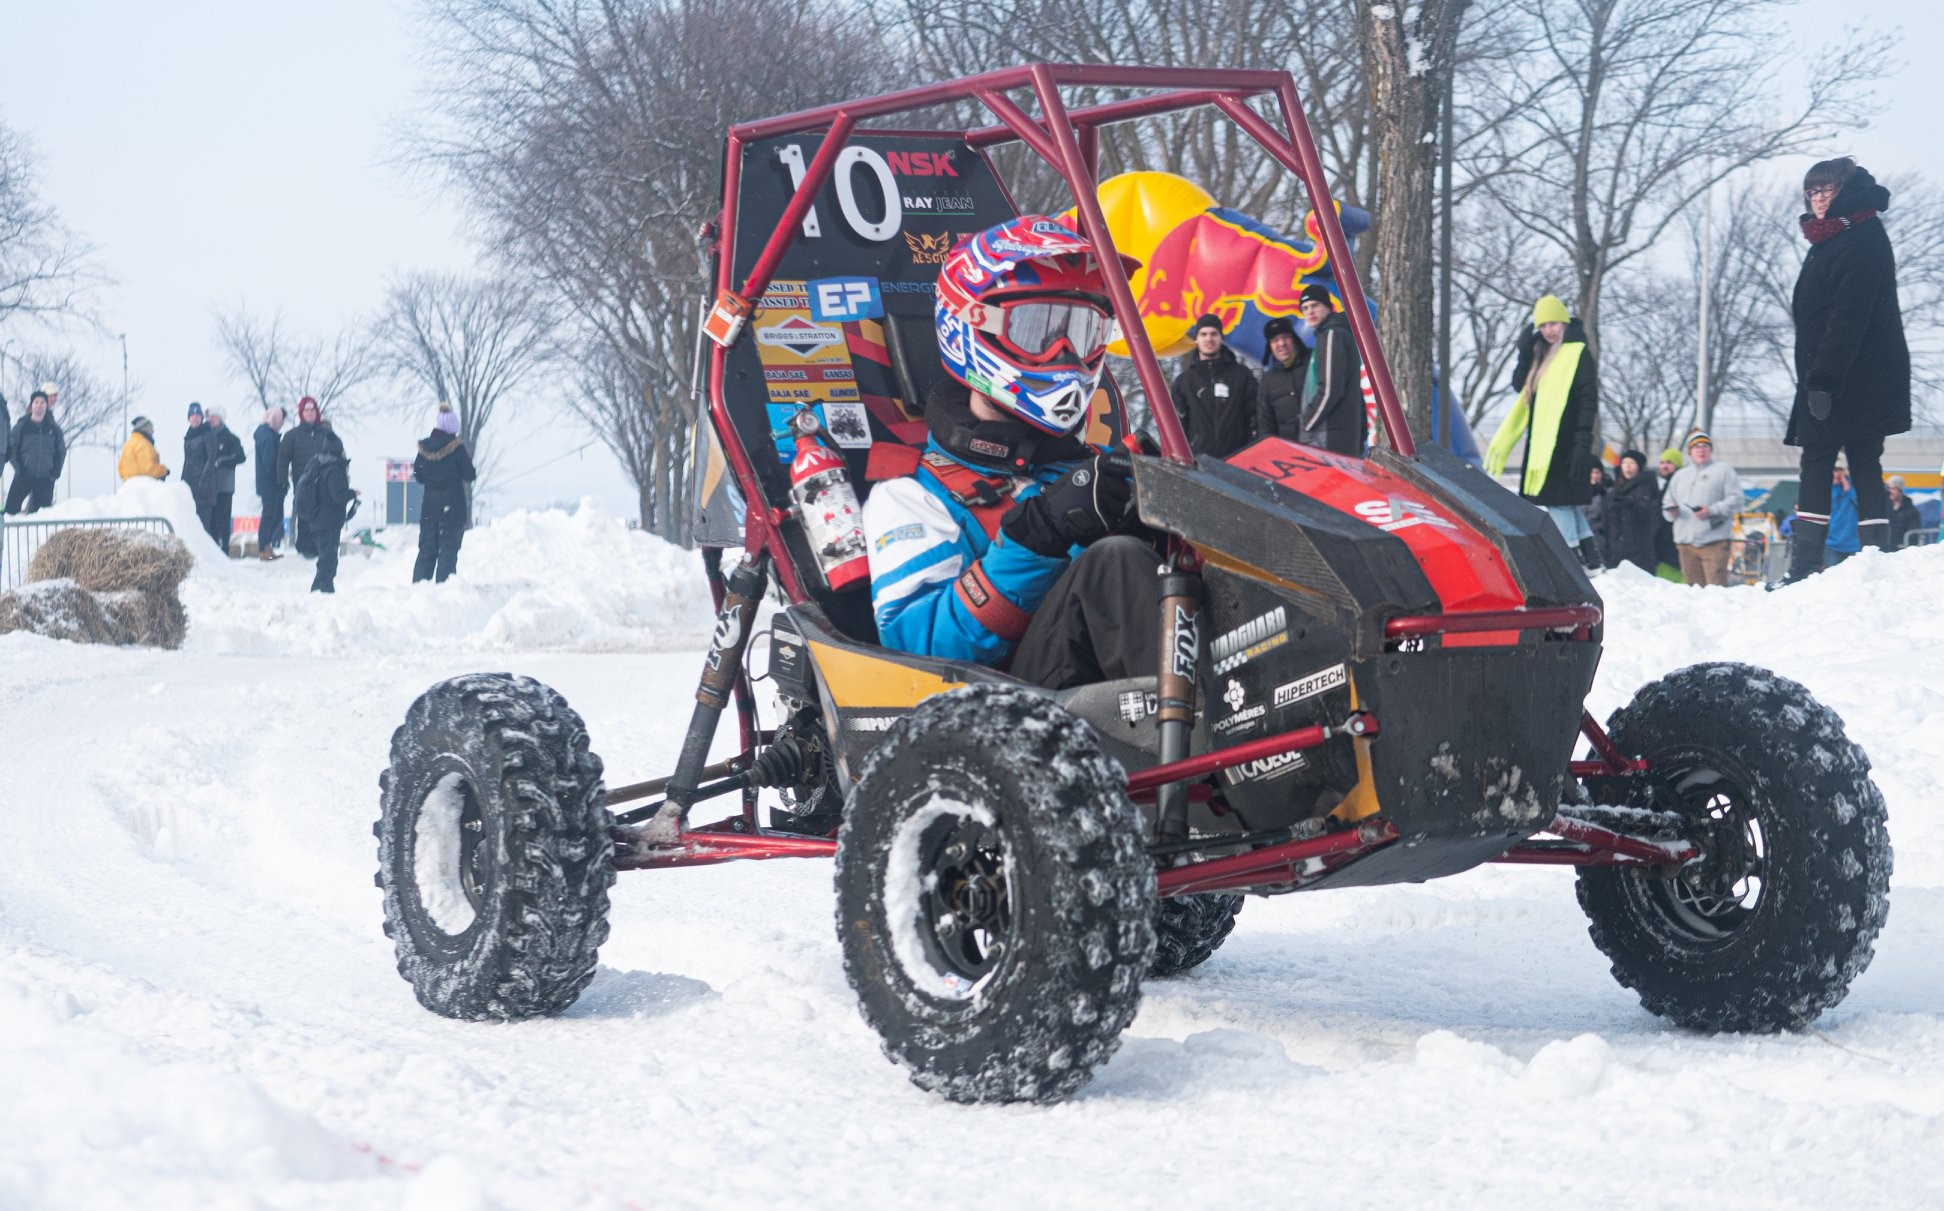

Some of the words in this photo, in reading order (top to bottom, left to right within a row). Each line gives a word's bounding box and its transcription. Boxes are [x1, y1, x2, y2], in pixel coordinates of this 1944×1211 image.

[886, 151, 959, 177] NSK
[779, 144, 902, 242] 10
[903, 196, 933, 209] RAY
[936, 196, 974, 213] JEAN
[761, 297, 799, 307] ASSED
[817, 282, 872, 317] EP
[763, 332, 795, 341] BRIGGS
[799, 332, 836, 340] STRATTON
[764, 371, 788, 380] BAJA
[789, 371, 807, 380] SAE
[823, 369, 854, 379] KANSAS
[770, 389, 791, 398] BAJA
[793, 389, 810, 398] SAE
[1173, 604, 1199, 685] FOX
[1210, 605, 1287, 661] VANGUARD
[1246, 630, 1288, 659] RACING
[1279, 666, 1345, 703] HIPERTECH
[1212, 704, 1266, 733] POLYMÈRES
